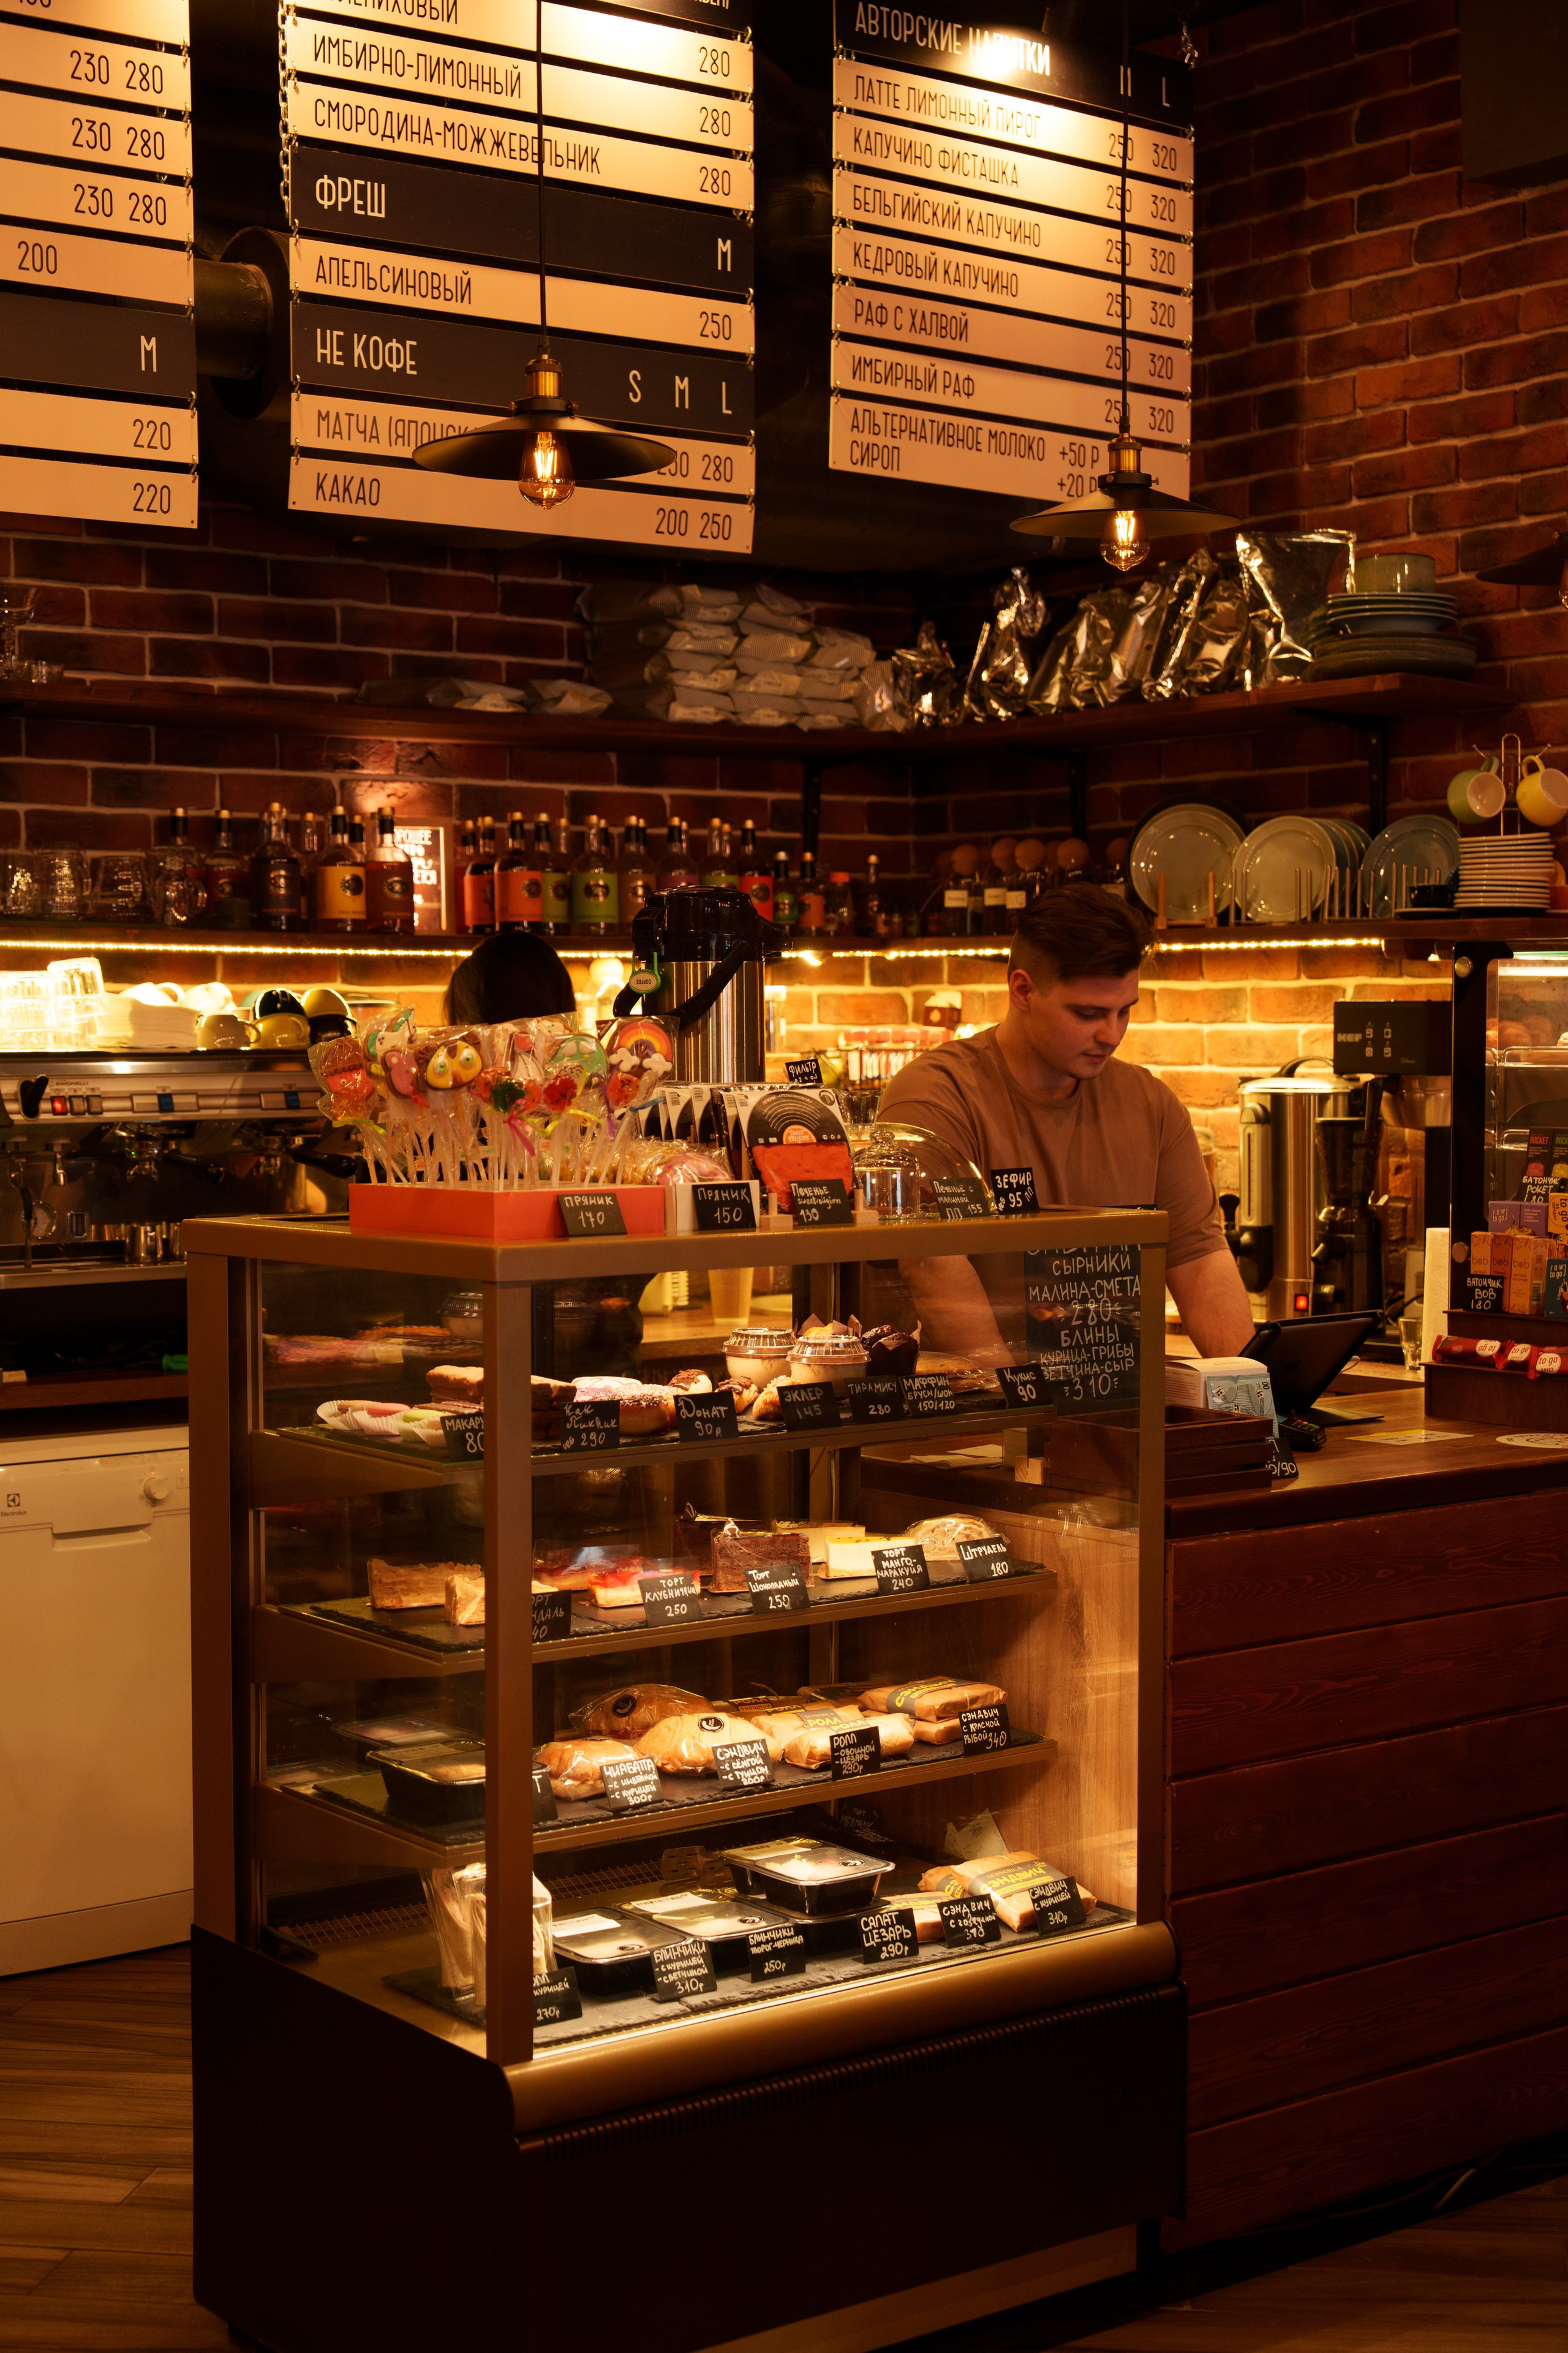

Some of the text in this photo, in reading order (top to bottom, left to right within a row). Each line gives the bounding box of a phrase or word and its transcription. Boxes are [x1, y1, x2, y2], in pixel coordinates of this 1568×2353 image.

[699, 46, 730, 77] 280
[855, 3, 1170, 108] АВТОРСКИЕ L
[70, 50, 163, 94] 230 280
[314, 34, 731, 137] ИМБИРНО-ЛИМОННЫЙ 280
[854, 75, 900, 110] ЛАТТЕ
[906, 87, 990, 129] ЛИМОННЫЙ
[1108, 134, 1134, 162] 250
[1152, 143, 1177, 172] 320
[72, 118, 164, 160] 230 280
[314, 98, 731, 197] СМОРОДИНА-МОЖЖЕВЕЛЬНИК 280
[853, 126, 1177, 223] КАПУЧИНО ФИСТАШКА 250 320
[74, 184, 166, 225] 230 280
[315, 175, 731, 271] ФРЕШ M
[853, 184, 1175, 276] БЕЛЬГИЙСКИЙ КАПУЧИНО 250 320
[18, 241, 58, 274] 200
[853, 241, 1175, 329] КЕДРОВЫЙ КАПУЧИНО 250 320
[315, 255, 731, 341] АПЕЛЬСИНОВЫЙ 250
[854, 298, 1174, 380] РАФ С ХАЛВОЙ 250 320
[140, 335, 157, 372] M
[317, 328, 732, 415] НЕ КОФЕ S M L
[852, 355, 938, 394] ИМБИРНЫЙ
[943, 371, 976, 399] РАФ
[1148, 406, 1174, 434] 320
[133, 418, 171, 450] 220
[851, 407, 983, 452] АЛЬТЕРНАТИВНОЕ
[987, 431, 1046, 463] МОЛОКО
[1059, 442, 1086, 469] +50
[317, 410, 733, 483] МАТЧА 280
[850, 440, 1084, 499] СИРОП +20
[133, 483, 171, 514] 220
[315, 473, 731, 541] КАКАО 200 250
[1337, 1033, 1363, 1043] KEF
[1529, 1136, 1549, 1145] ROCKET
[995, 1171, 1032, 1188] ЗЕФИР
[1522, 1176, 1562, 1185] БАТОНЧИК
[564, 1195, 614, 1208] ПРЯНИК
[1008, 1192, 1023, 1208] 95
[714, 1207, 742, 1224] 150
[799, 1208, 820, 1223] 130
[946, 1204, 984, 1218] ПП 155
[1052, 1252, 1131, 1276] СЫРНИКИ
[1513, 1258, 1529, 1269] bob
[1467, 1277, 1502, 1289] БАТОНЧИК
[1471, 1299, 1491, 1310] 180
[1060, 1323, 1120, 1347] БЛИНЫ
[1041, 1342, 1134, 1365] КУРИЦА-ГРИБЫ
[1520, 1346, 1529, 1355] go
[1548, 1356, 1558, 1365] go
[847, 1382, 897, 1396] ТИРАМИСУ
[903, 1376, 950, 1391] МАФФИН
[1017, 1383, 1036, 1402] 90
[1072, 1373, 1111, 1400] 310
[783, 1387, 824, 1403] ЭКЛЕР
[868, 1404, 891, 1415] 280
[580, 1431, 606, 1448] 290
[882, 1547, 906, 1558] ТОРТ
[990, 1561, 1009, 1577] 180
[659, 1576, 685, 1588] ТОРТ
[892, 1577, 914, 1591] 240
[665, 1603, 687, 1617] 250
[768, 1595, 791, 1610] 250
[806, 1717, 843, 1728] РОЛЛ
[830, 1720, 867, 1731] РОЛЛ
[961, 1708, 1000, 1723] СЭНДВИЧ
[969, 1718, 1001, 1734] КРАСНОЙ
[833, 1732, 858, 1749] РОЛЛ
[963, 1730, 1008, 1750] РЫБОЙ 340
[716, 1742, 766, 1761] СЭНДВИЧ
[603, 1758, 655, 1778] ЧИАБАТТА
[621, 1781, 657, 1798] КУРИЦЕЙ
[979, 1866, 1047, 1895] СЭНДВИЧ
[1029, 1879, 1068, 1900] СЭНДВИЧ
[1039, 1889, 1072, 1908] КУРИЦЕЙ
[860, 1911, 900, 1932] САЛАТ
[748, 1926, 795, 1946] БЛИНЧИКИ
[862, 1924, 911, 1947] ЦЕЗАРЬ
[964, 1927, 986, 1940] 310
[653, 1941, 706, 1964] БЛИНЧИКИ
[750, 1934, 804, 1955] ТВОРОГ-ЧЕРНИКА
[666, 1954, 704, 1971] КУРИЦЕЙ
